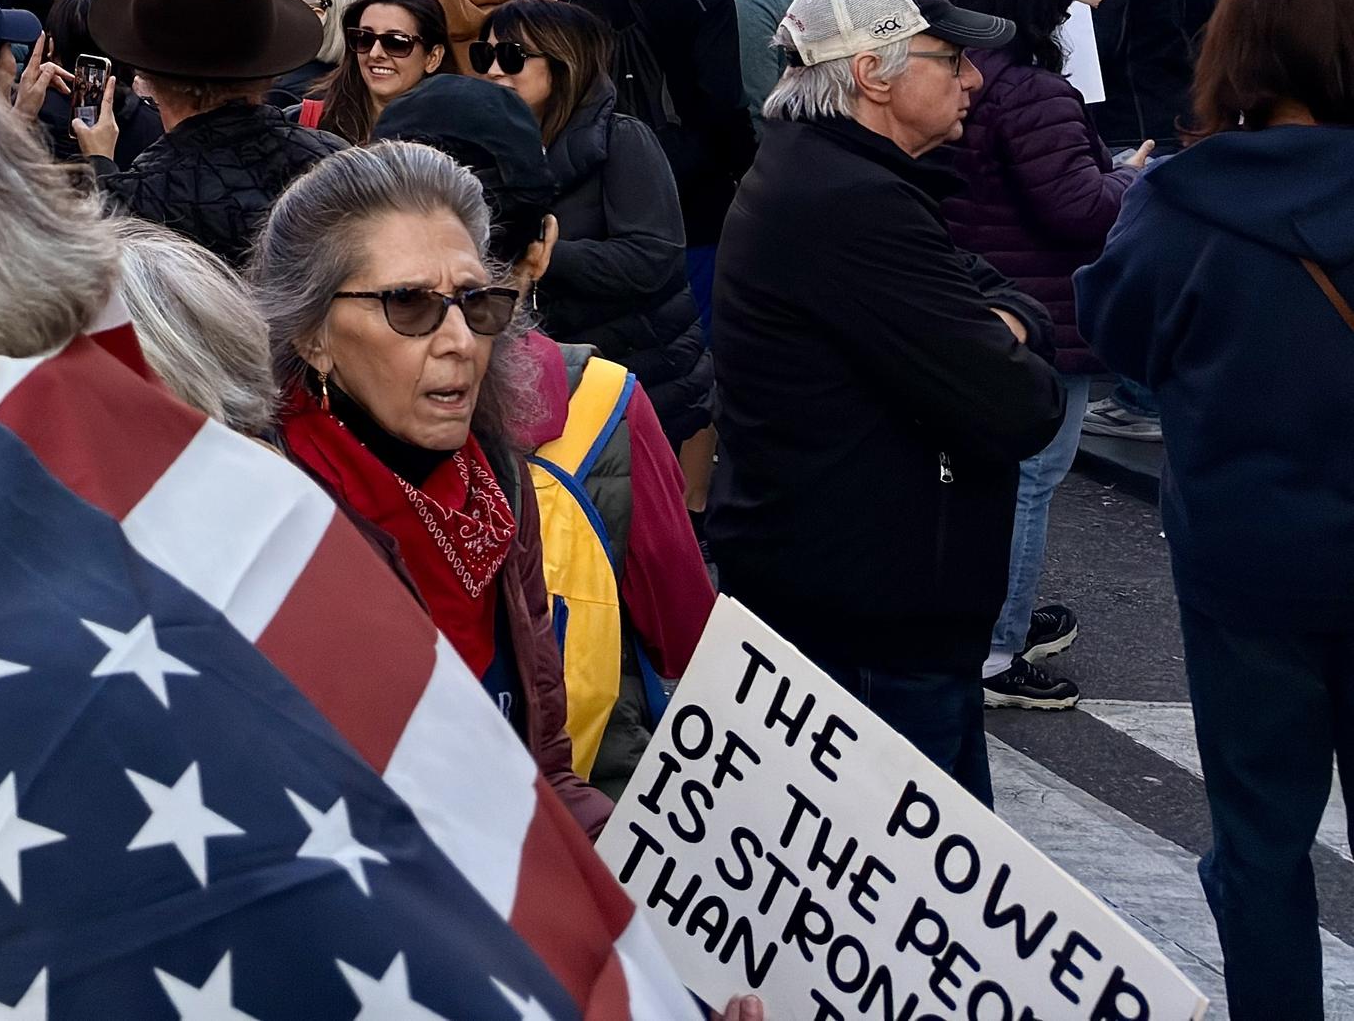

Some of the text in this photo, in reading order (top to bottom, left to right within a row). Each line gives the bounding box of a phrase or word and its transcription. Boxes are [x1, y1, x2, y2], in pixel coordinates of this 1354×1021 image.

[618, 821, 779, 990] THAN
[637, 751, 943, 1021] IS STRON
[670, 704, 762, 790] OF
[779, 783, 897, 925] THE
[735, 641, 1150, 1021] THE POWER
